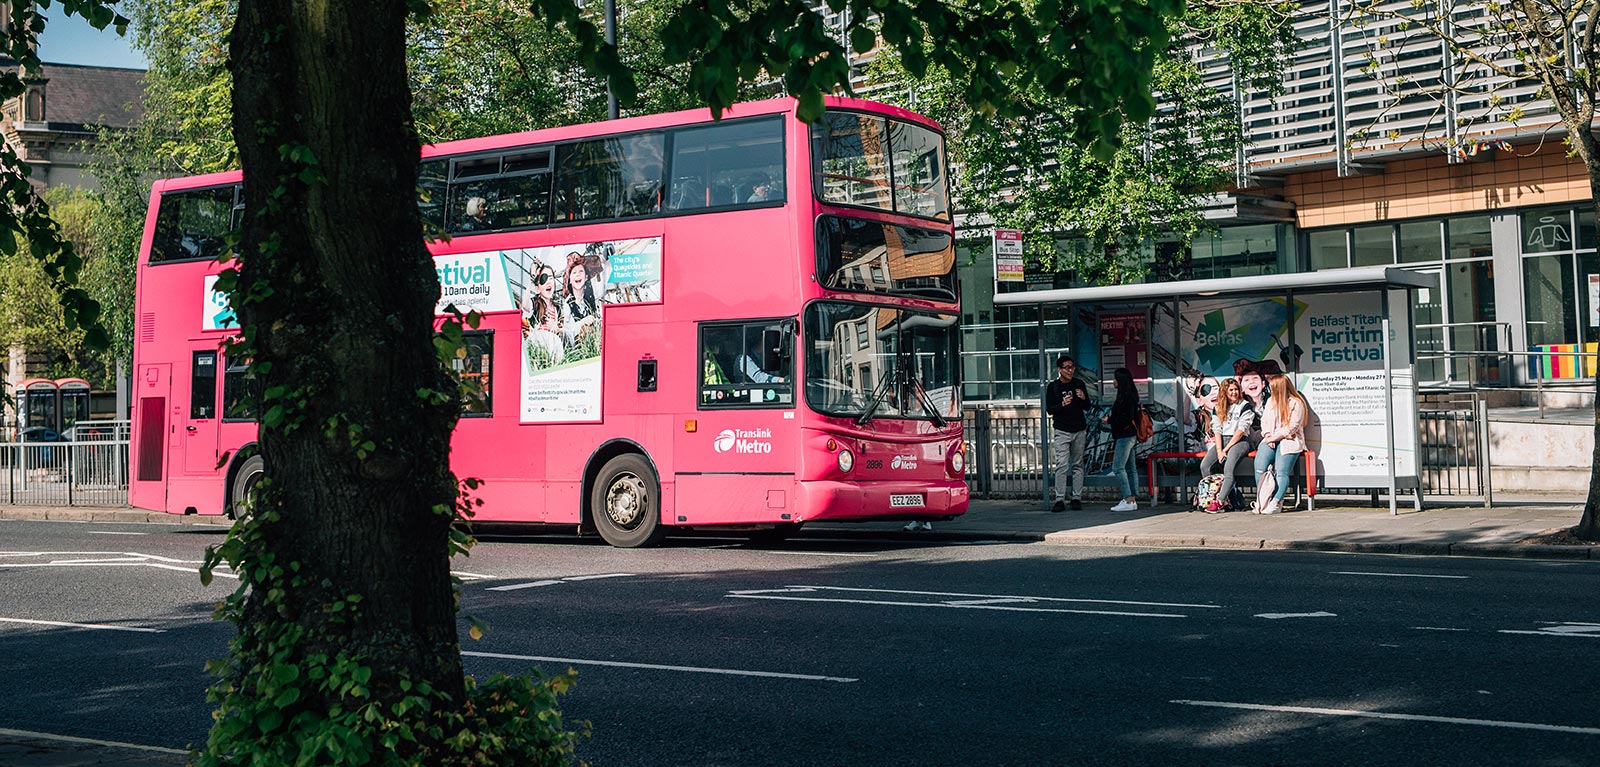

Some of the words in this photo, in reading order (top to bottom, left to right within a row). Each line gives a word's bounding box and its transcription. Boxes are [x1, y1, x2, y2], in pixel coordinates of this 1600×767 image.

[436, 258, 490, 285] stival
[444, 286, 467, 296] 10am
[469, 284, 490, 296] daily
[1310, 315, 1350, 327] Belfast
[1352, 314, 1392, 325] Titan
[1312, 343, 1384, 362] Festival
[735, 428, 772, 438] Translink
[736, 439, 772, 453] Metro
[866, 460, 882, 469] 2896
[901, 461, 917, 470] Metro
[892, 496, 905, 505] EEZ
